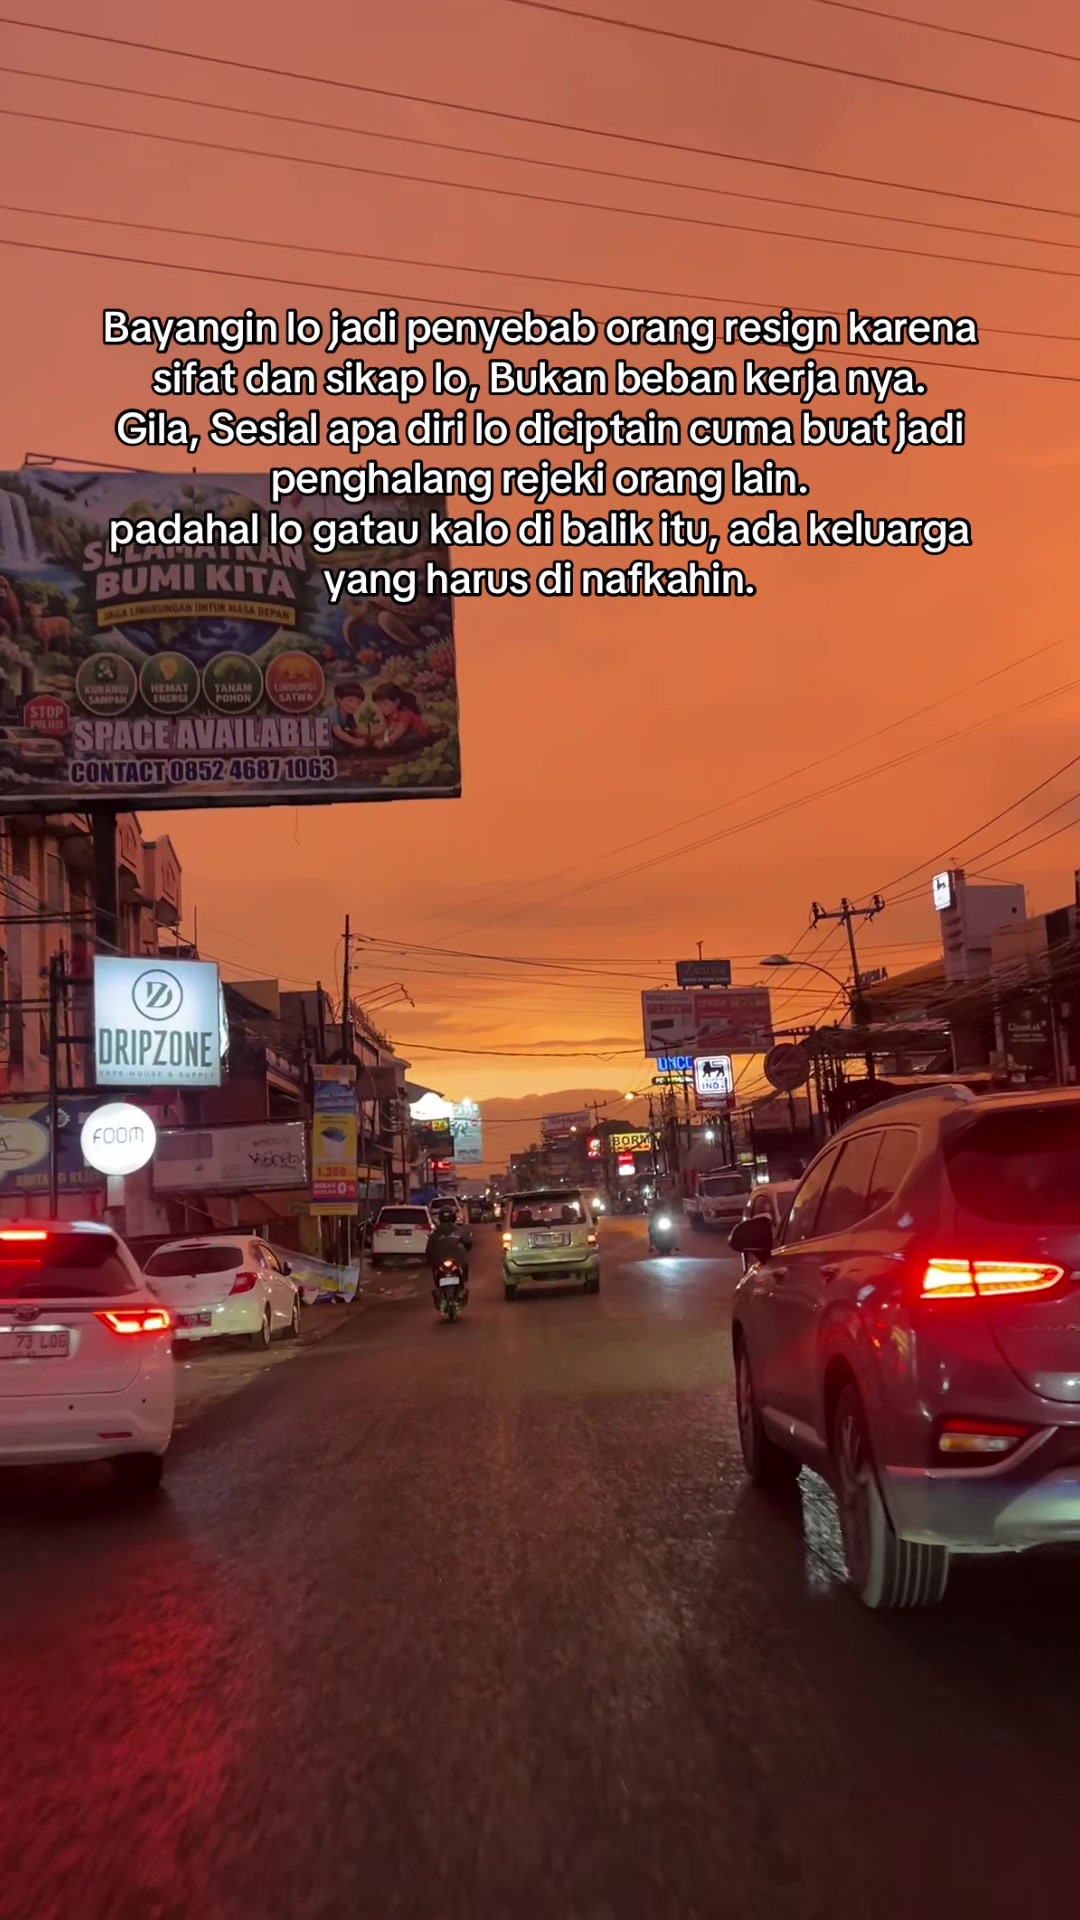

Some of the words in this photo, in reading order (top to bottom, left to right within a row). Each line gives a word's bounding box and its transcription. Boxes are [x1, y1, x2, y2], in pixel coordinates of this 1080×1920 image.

[96, 563, 195, 600] BUMI
[206, 564, 296, 600] KITA
[103, 608, 128, 621] JAGA
[130, 604, 192, 617] LINGKUNGAN
[195, 603, 225, 613] UNTUK
[228, 604, 257, 615] MASA
[259, 607, 290, 621] DEPAN
[150, 683, 189, 693] HEMAT
[214, 683, 253, 693] TANAM
[273, 683, 317, 692] LINDUNGI
[153, 694, 188, 703] ENERGI
[215, 693, 251, 703] POHON
[279, 692, 313, 702] SATWA
[30, 705, 64, 719] STOP
[74, 718, 170, 751] SPACE
[176, 716, 330, 750] AVAILABLE
[71, 761, 165, 784] CONTACT
[171, 760, 224, 781] 0852
[229, 758, 280, 781] 4687
[284, 757, 335, 779] 1063
[99, 1028, 213, 1068] DRIPZONE
[93, 1126, 145, 1144] FOOM
